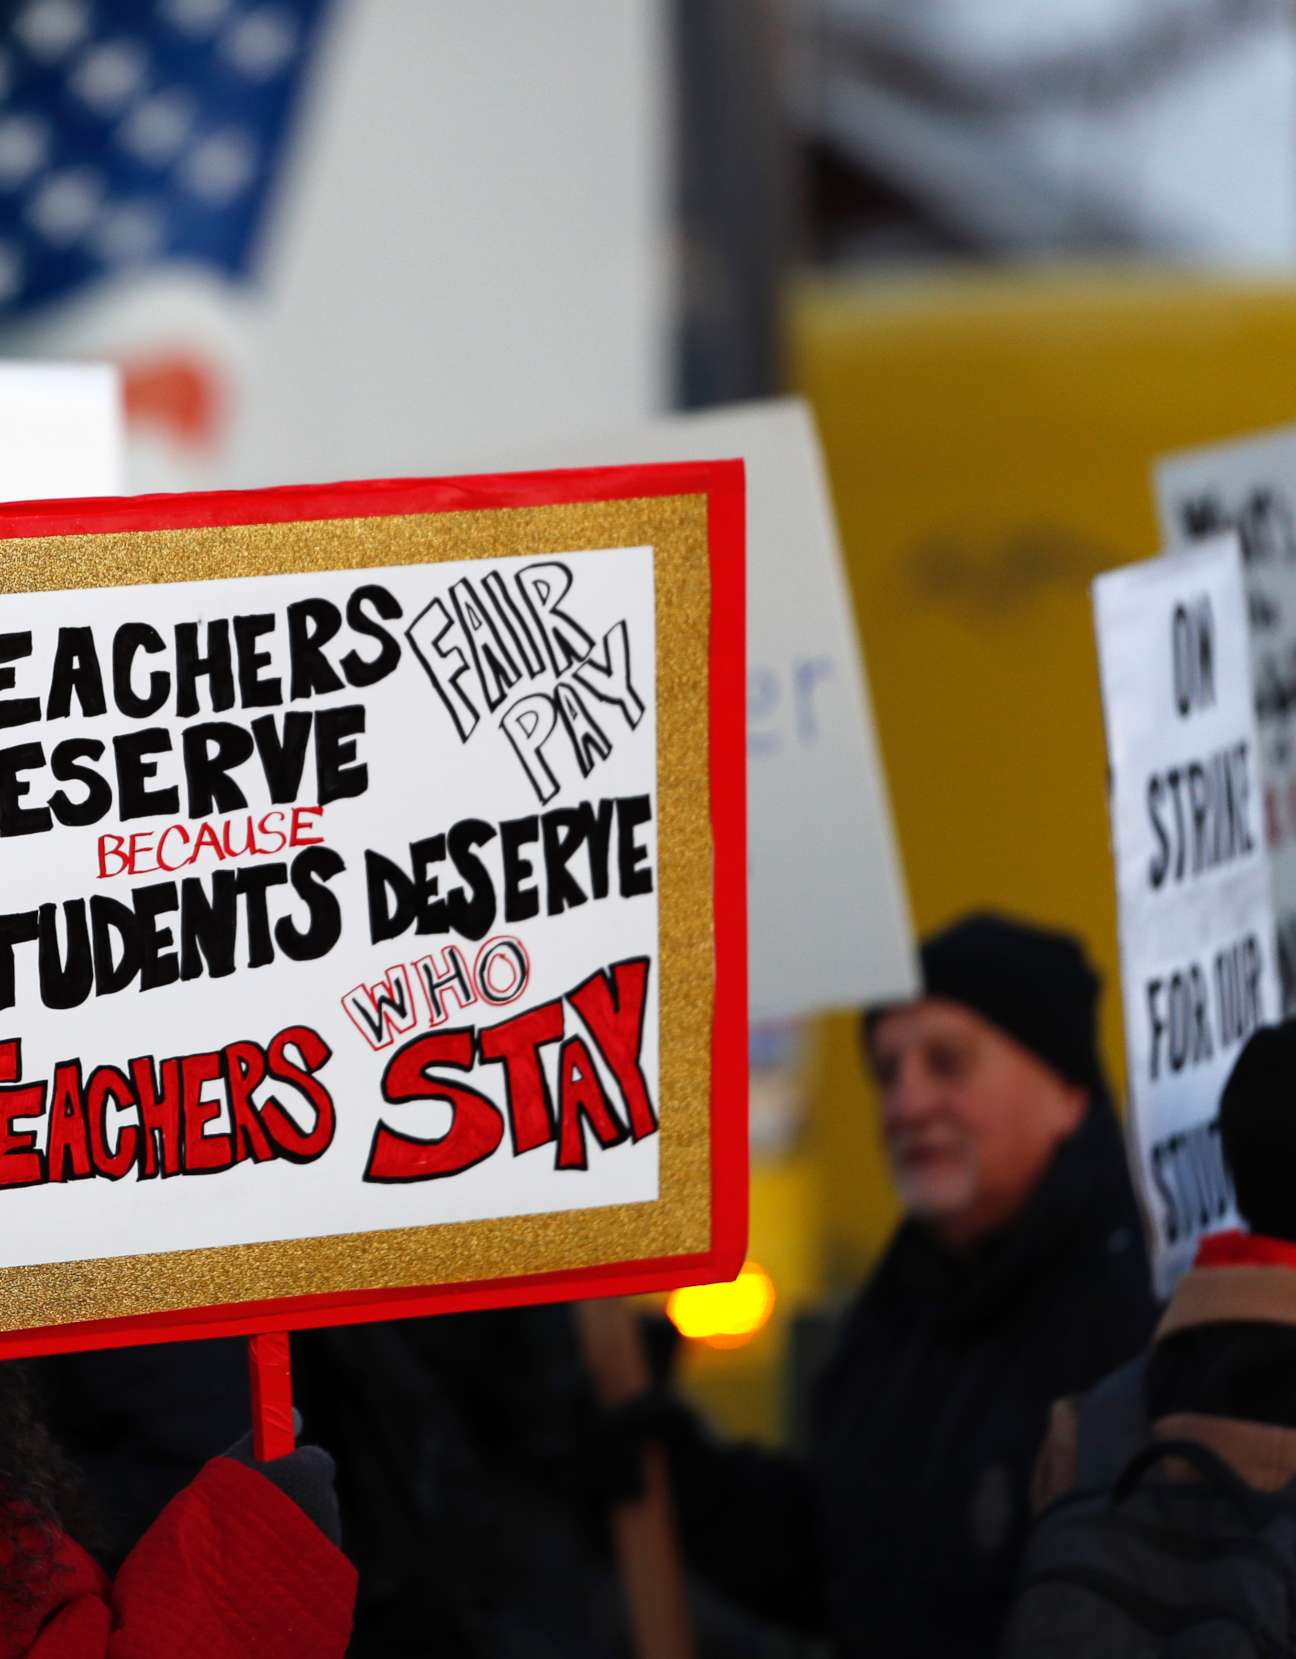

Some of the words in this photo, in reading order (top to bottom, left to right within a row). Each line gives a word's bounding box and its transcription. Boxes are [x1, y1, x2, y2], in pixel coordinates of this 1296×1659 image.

[404, 561, 596, 744] FAIR
[499, 619, 646, 806] PAY
[1172, 594, 1217, 720] ON
[96, 805, 325, 879] BECAUSE
[364, 794, 654, 945] DESERVE
[1146, 740, 1256, 892] STRIKE
[341, 935, 530, 1051] WHO
[1146, 960, 1214, 1082] FOR
[1213, 932, 1263, 1050] OUR
[362, 955, 659, 1184] STAY
